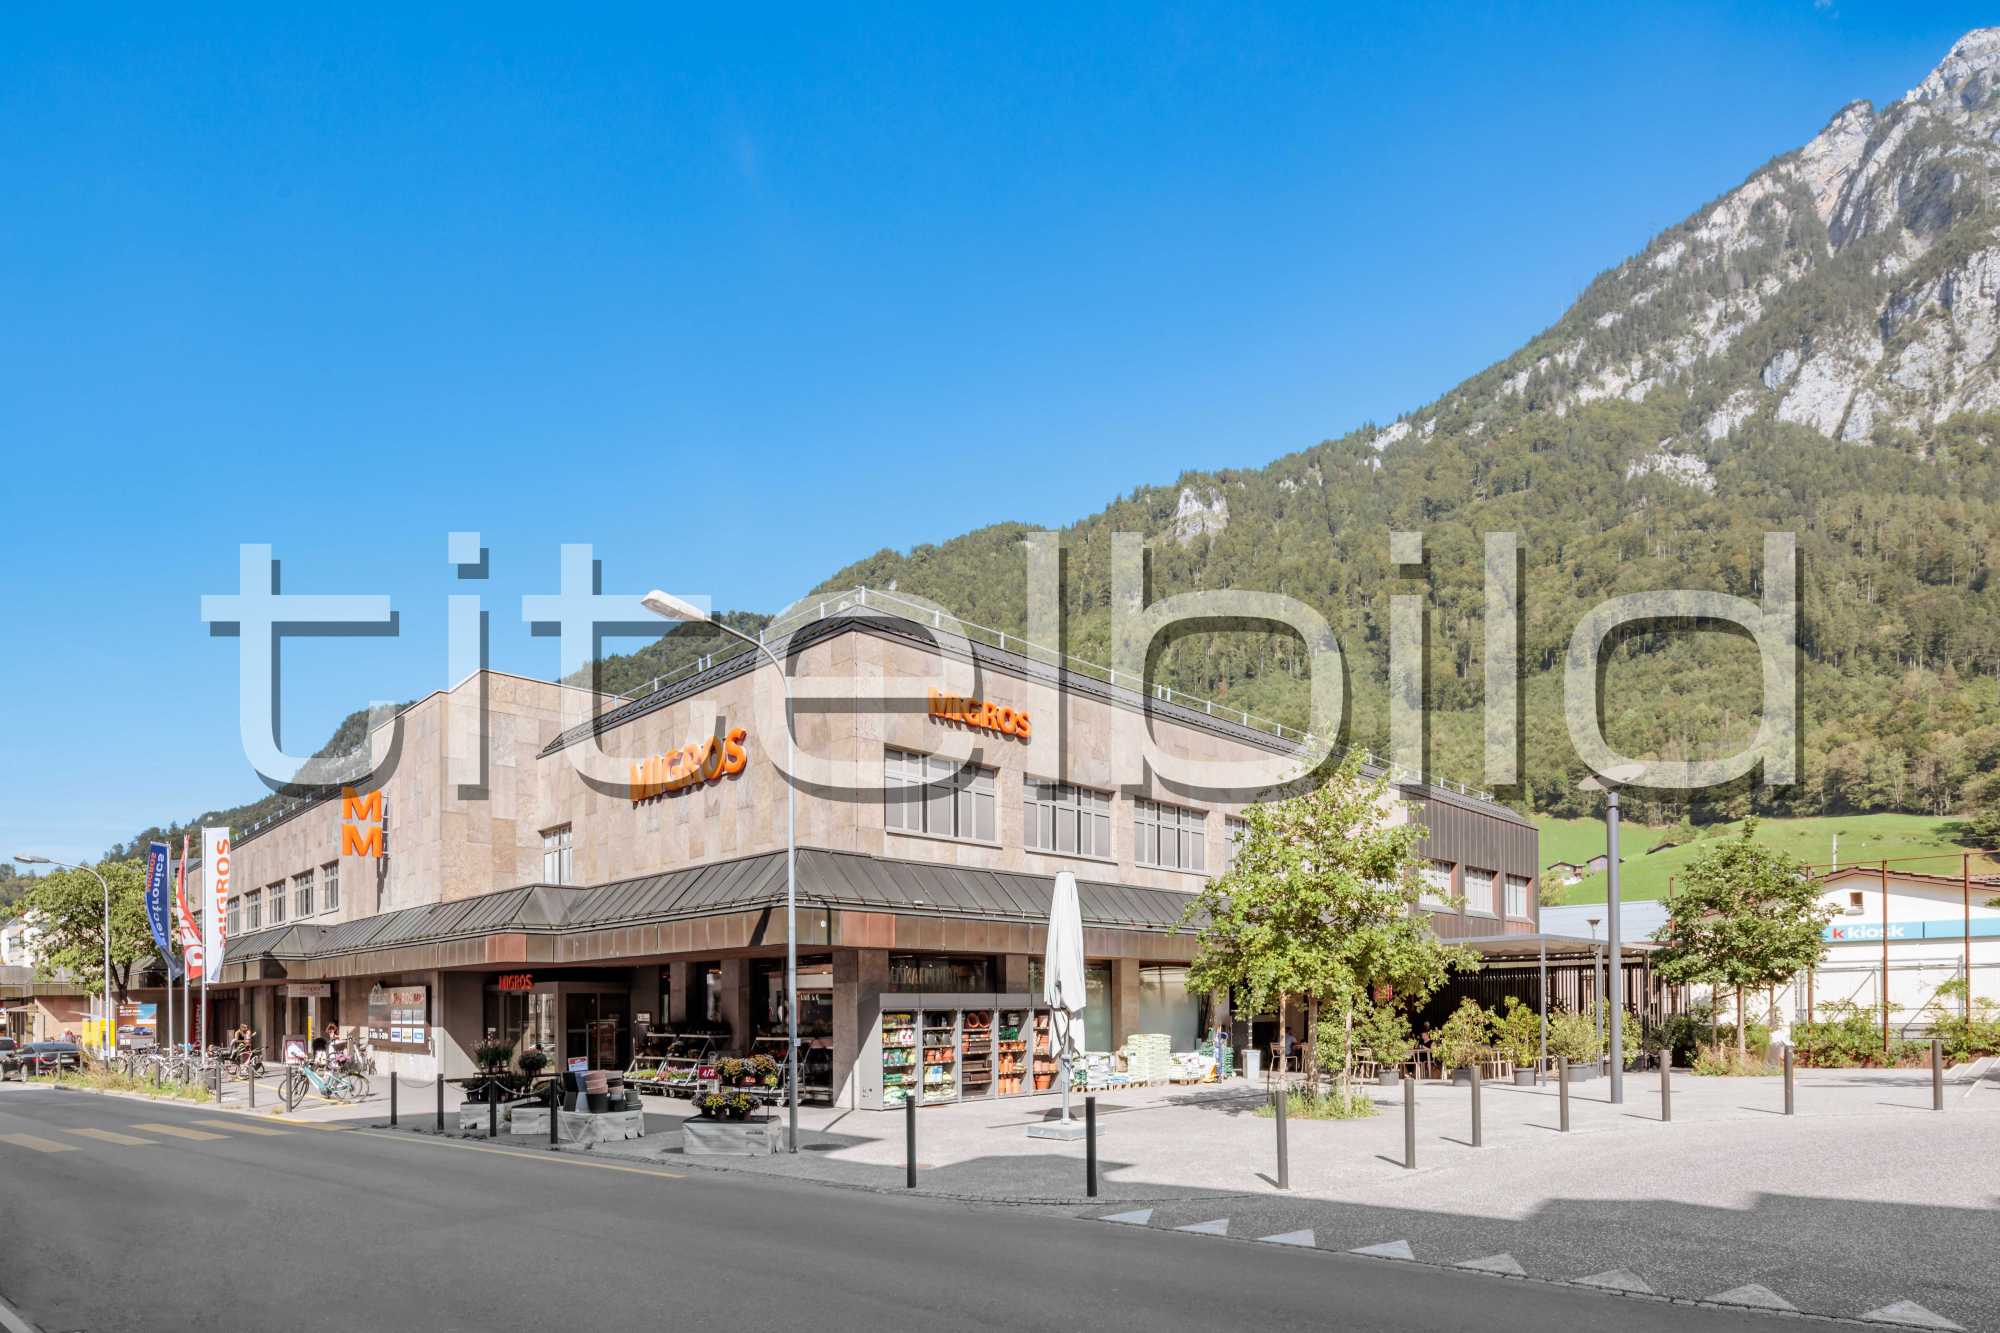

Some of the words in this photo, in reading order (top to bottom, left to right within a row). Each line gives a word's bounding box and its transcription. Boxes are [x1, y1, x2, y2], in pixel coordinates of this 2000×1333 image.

[928, 687, 1031, 737] MIGROS
[630, 728, 747, 802] MIGROS
[498, 974, 534, 991] MIGROS
